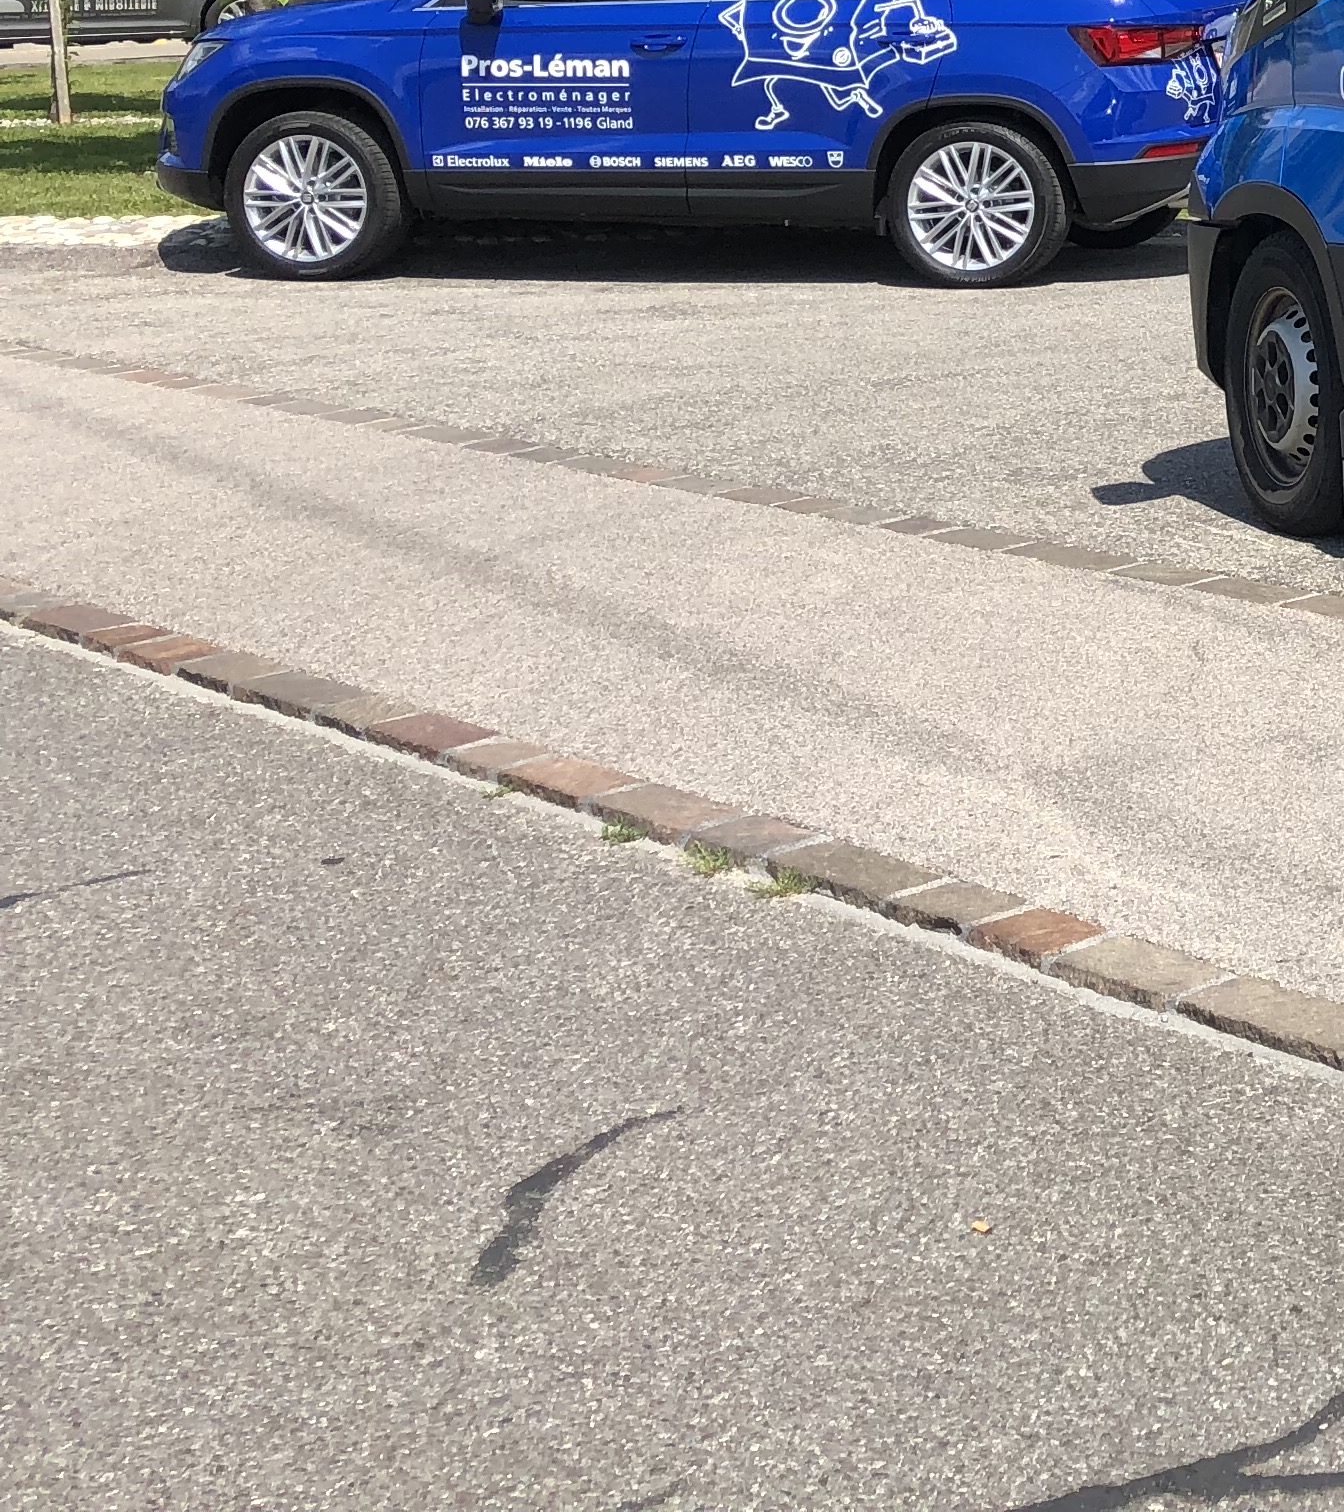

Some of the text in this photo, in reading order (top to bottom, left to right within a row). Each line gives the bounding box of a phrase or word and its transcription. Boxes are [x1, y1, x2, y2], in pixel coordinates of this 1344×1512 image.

[461, 53, 631, 78] Pros-Léman
[462, 88, 631, 104] Electroménager
[465, 116, 489, 129] 076
[492, 116, 515, 129] 367
[518, 116, 534, 129] 93
[596, 116, 634, 130] Gland
[446, 155, 510, 168] Electrolux
[523, 156, 573, 168] Miele
[602, 156, 641, 168] BOSCH
[653, 156, 709, 168] SIEMENS
[721, 154, 756, 168] AEG
[768, 155, 813, 168] WESCO
